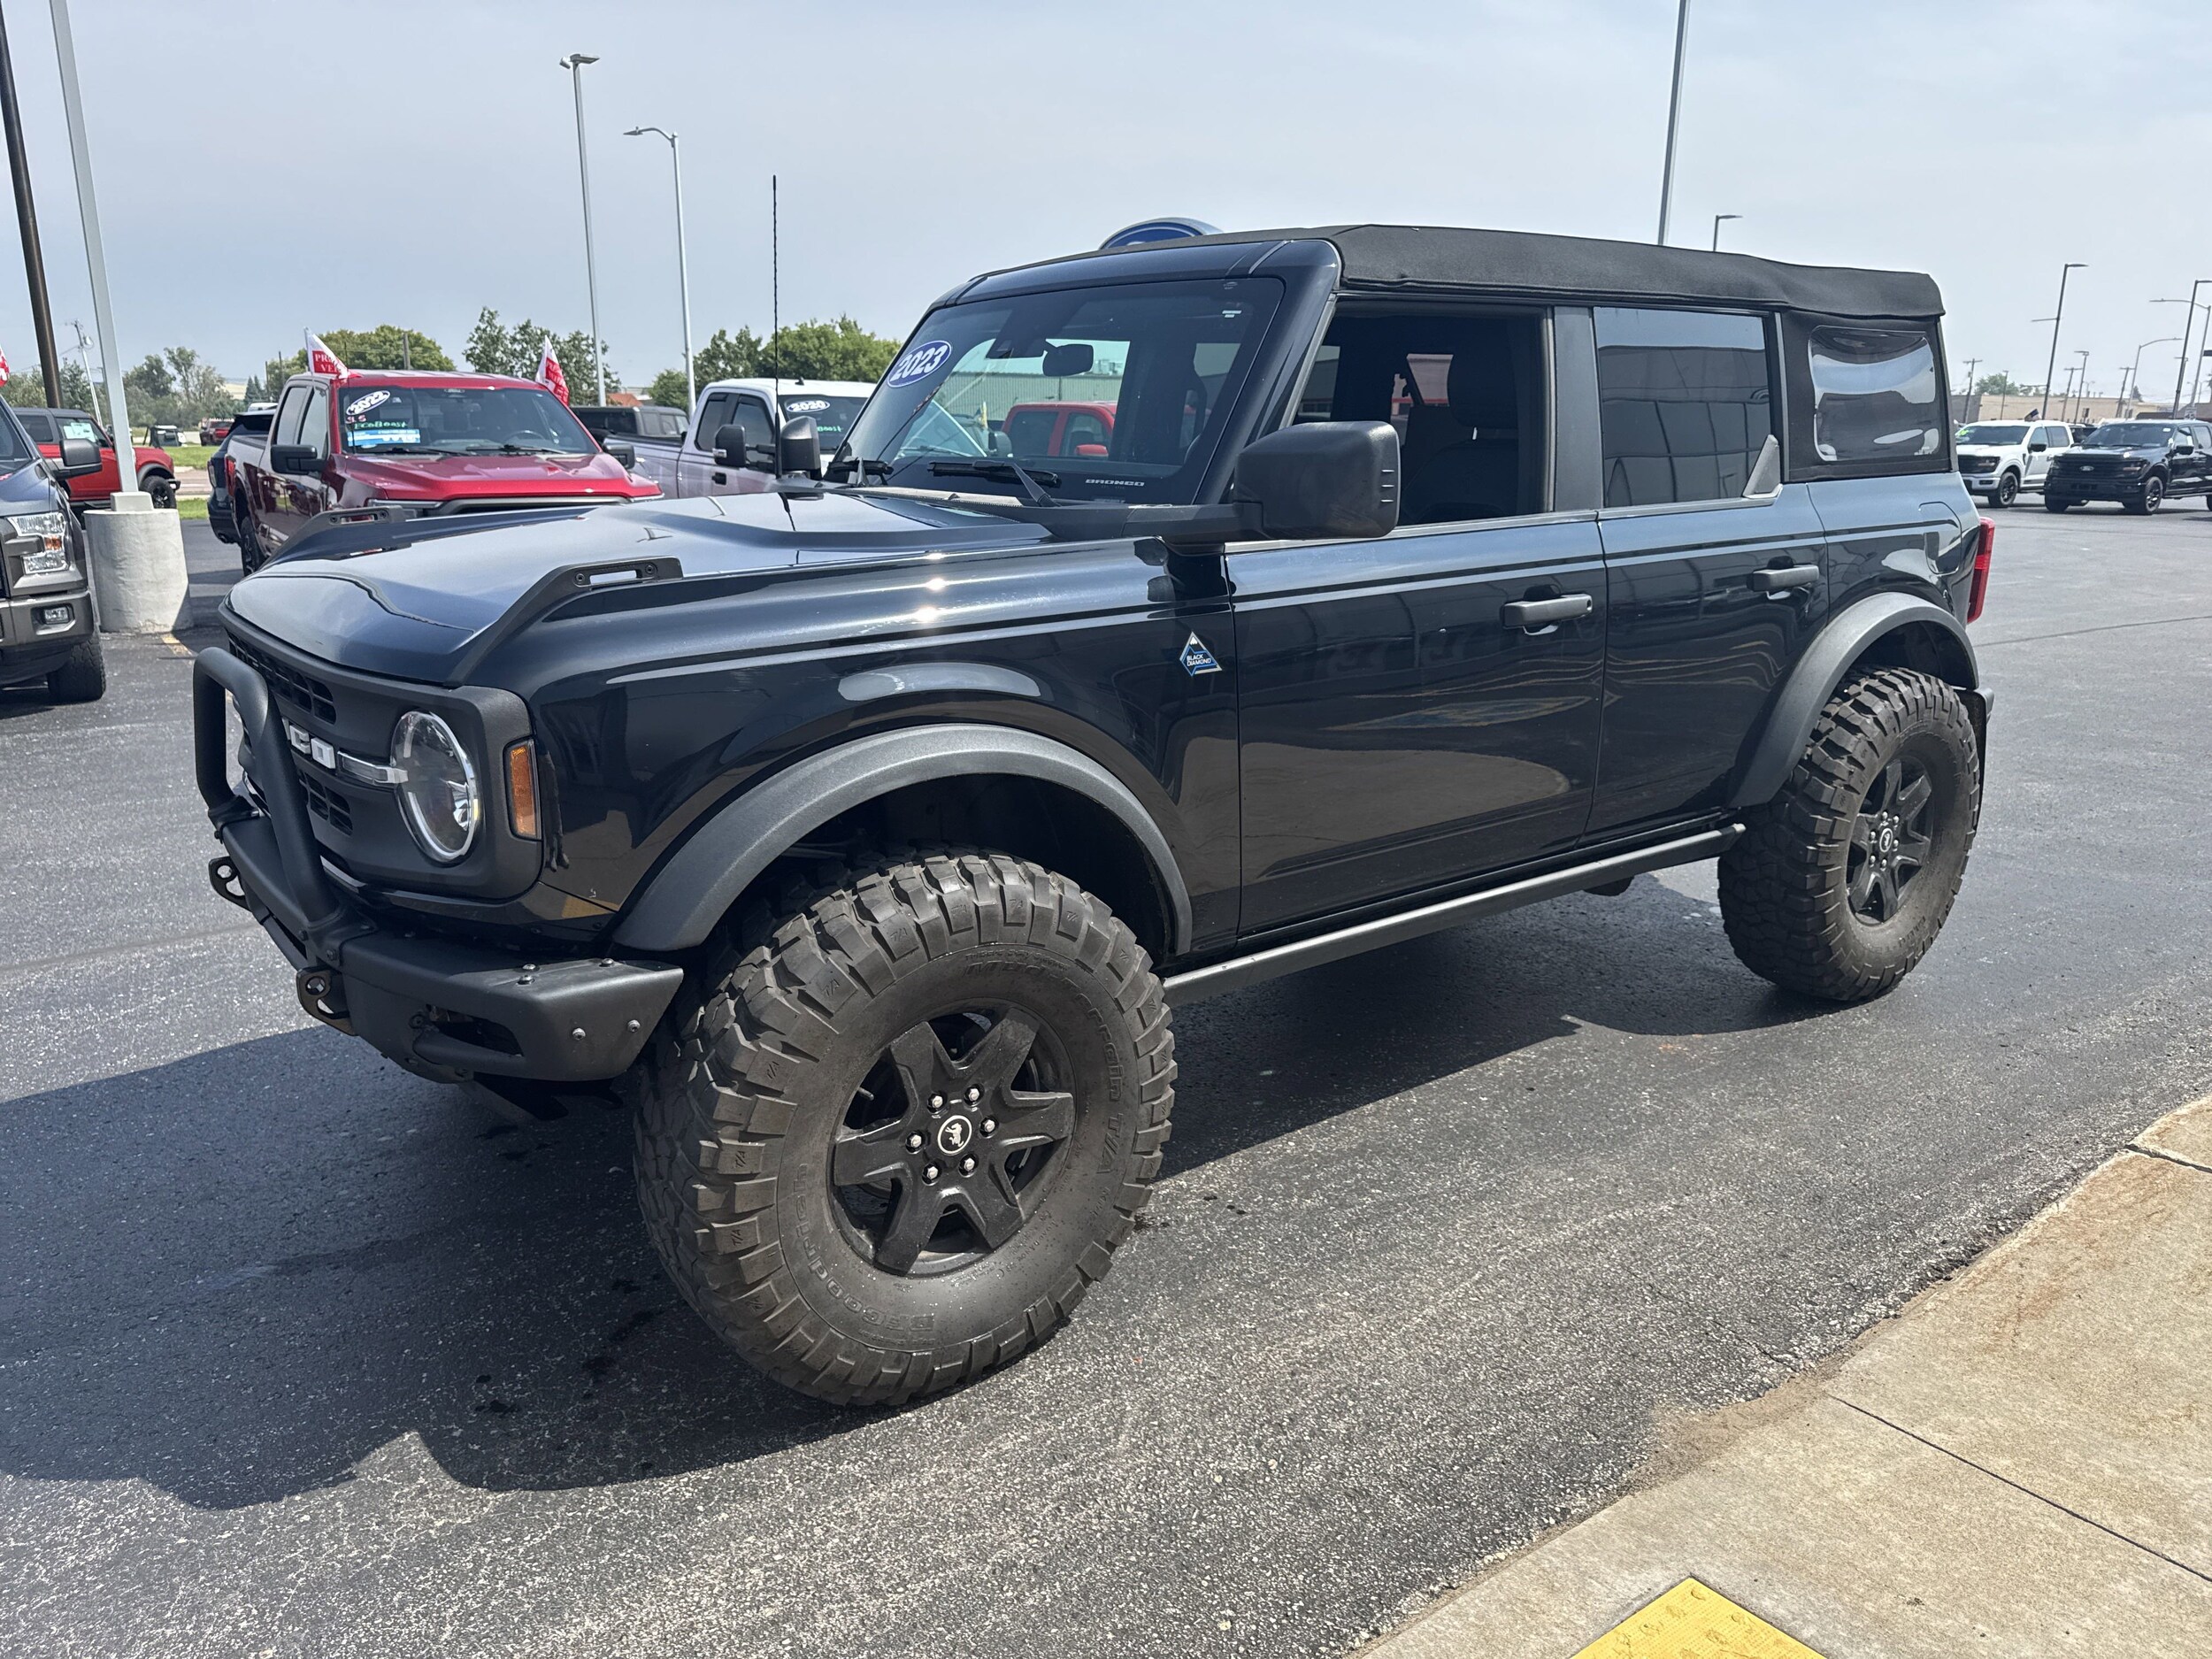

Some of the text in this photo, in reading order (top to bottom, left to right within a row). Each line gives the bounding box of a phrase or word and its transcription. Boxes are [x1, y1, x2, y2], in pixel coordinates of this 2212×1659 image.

[889, 344, 949, 382] 2023
[790, 400, 827, 412] 2020
[1187, 657, 1211, 667] DIAMOND
[281, 717, 336, 769] CO
[1096, 1112, 1124, 1174] T/A
[794, 1163, 935, 1332] BFGoodrich
